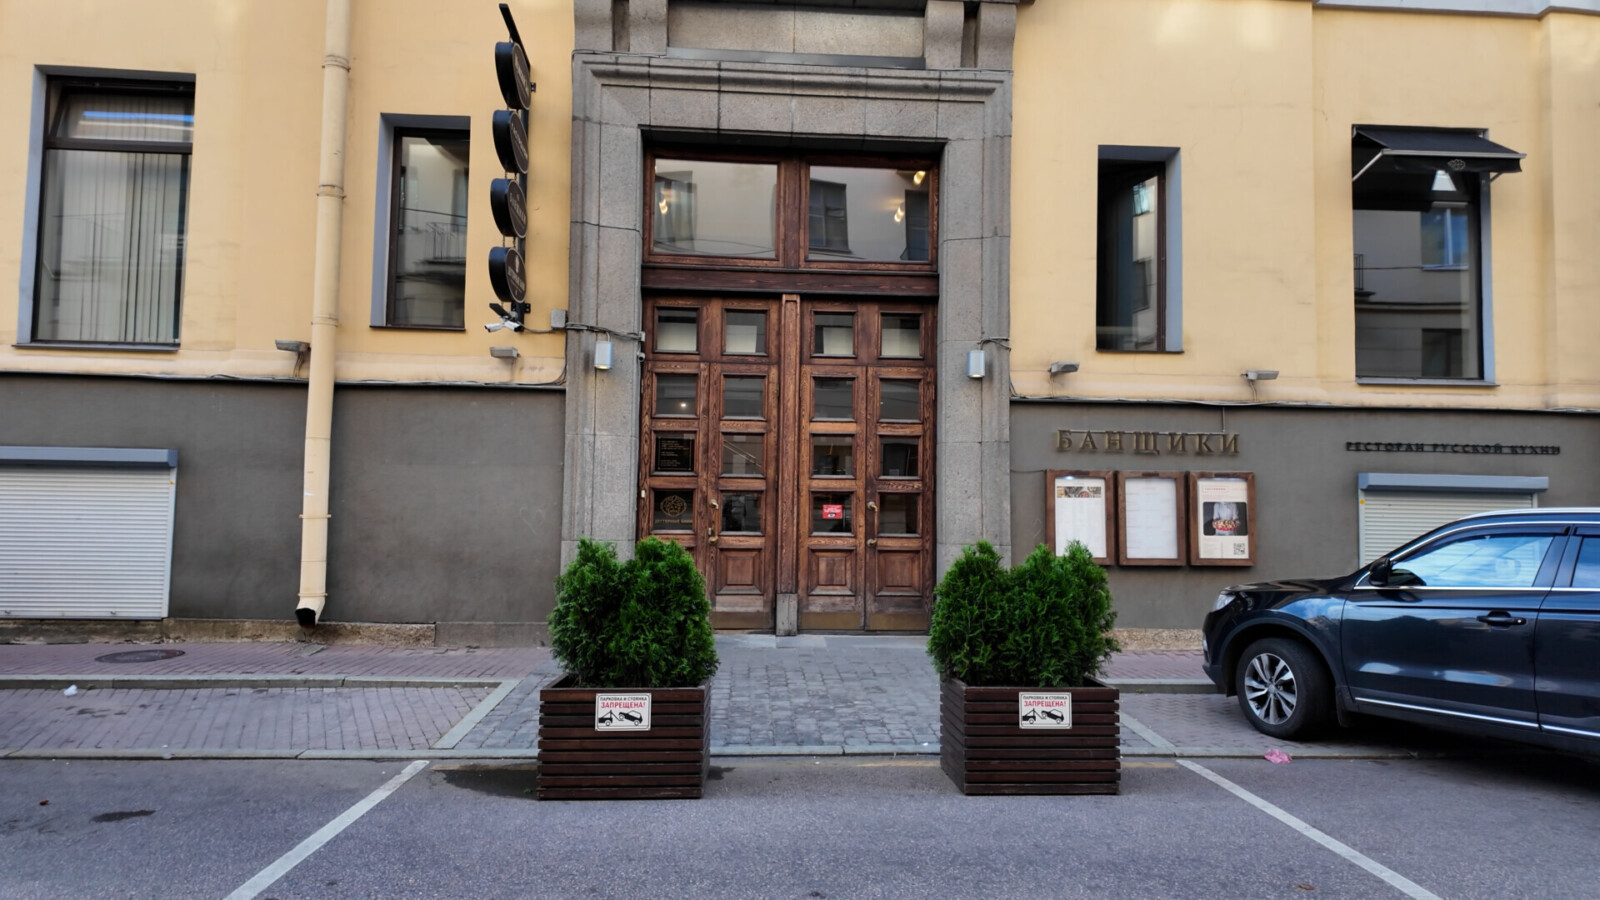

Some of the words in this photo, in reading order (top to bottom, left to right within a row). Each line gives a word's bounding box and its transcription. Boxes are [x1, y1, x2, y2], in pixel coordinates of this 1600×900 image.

[1056, 429, 1240, 456] БАНЩИКИ
[1346, 442, 1424, 452] РЕСТОРАН
[1433, 442, 1503, 454] РУССКОЙ
[1510, 444, 1561, 455] КУХНИ
[600, 701, 646, 709] ЗАПРЕЩЕНА!
[1024, 700, 1067, 708] ЗАПРЕЩЕНА!
